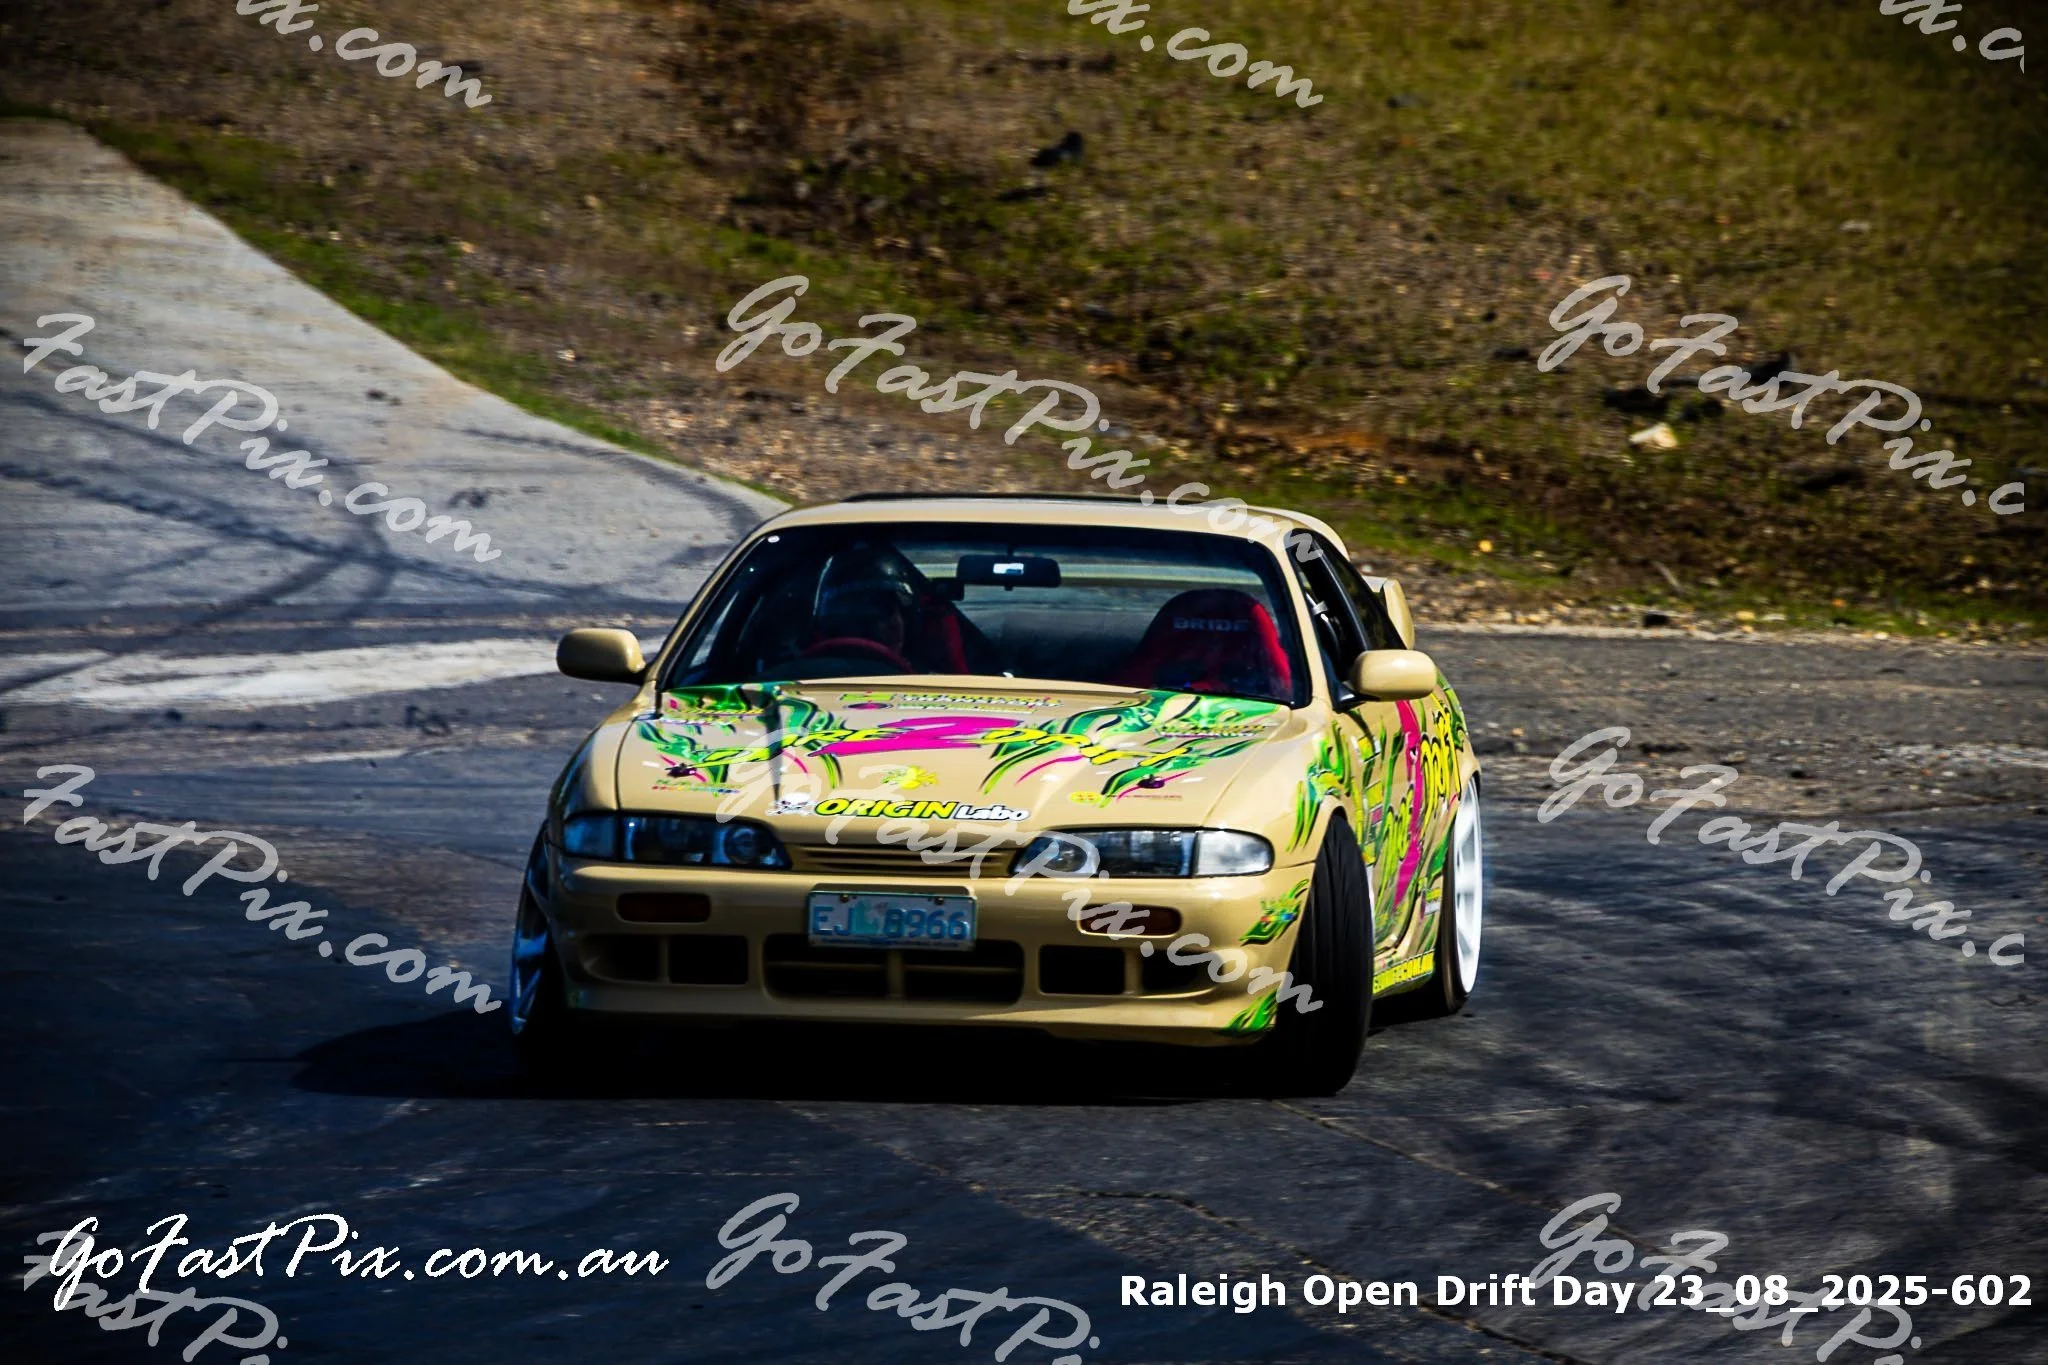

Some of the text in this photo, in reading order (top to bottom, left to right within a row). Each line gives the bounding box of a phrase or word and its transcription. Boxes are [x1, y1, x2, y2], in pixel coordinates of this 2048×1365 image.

[814, 798, 1032, 822] ORIGIN Labo
[884, 908, 971, 941] 8966
